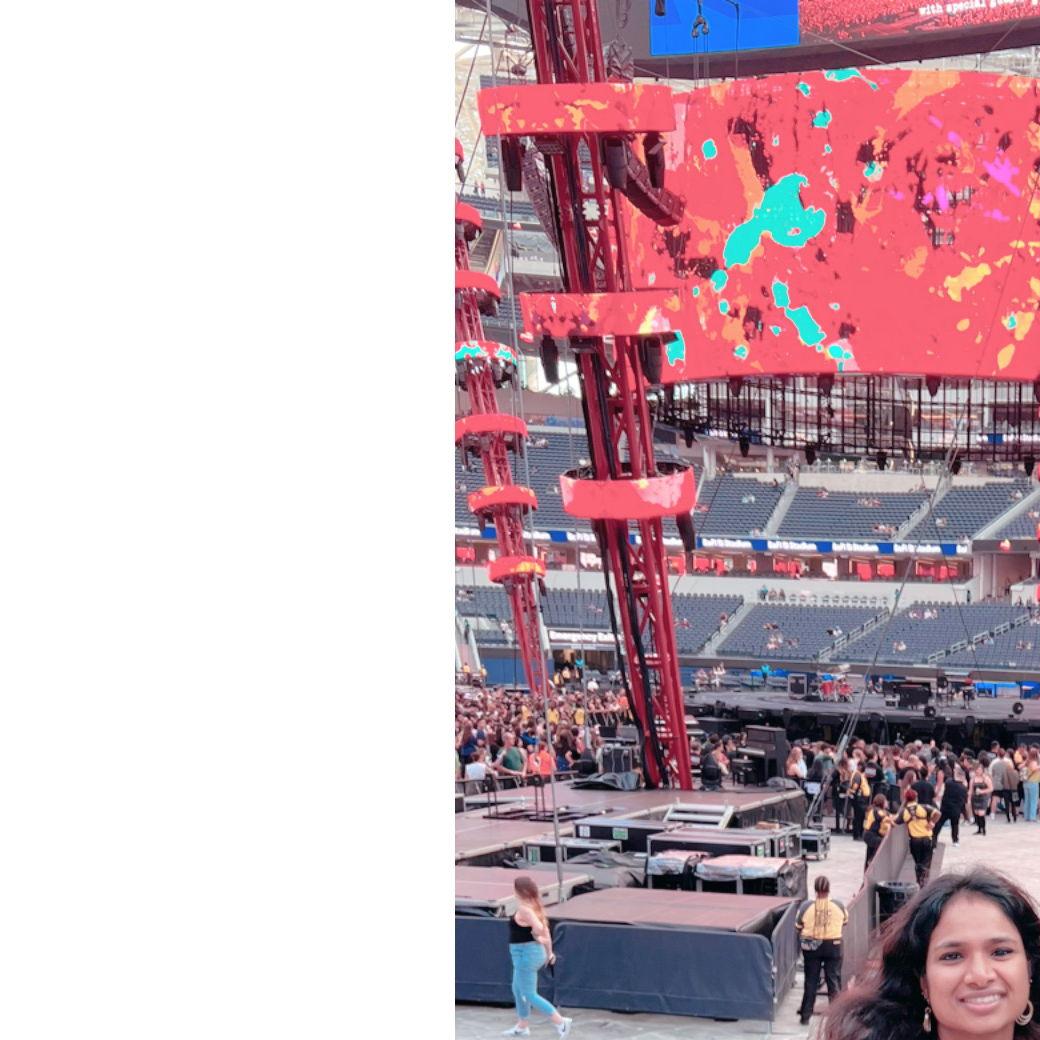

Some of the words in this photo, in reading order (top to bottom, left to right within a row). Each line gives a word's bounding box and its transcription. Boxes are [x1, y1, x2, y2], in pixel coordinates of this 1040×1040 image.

[919, 3, 943, 16] with
[946, 0, 985, 15] special
[549, 630, 597, 642] Emergency
